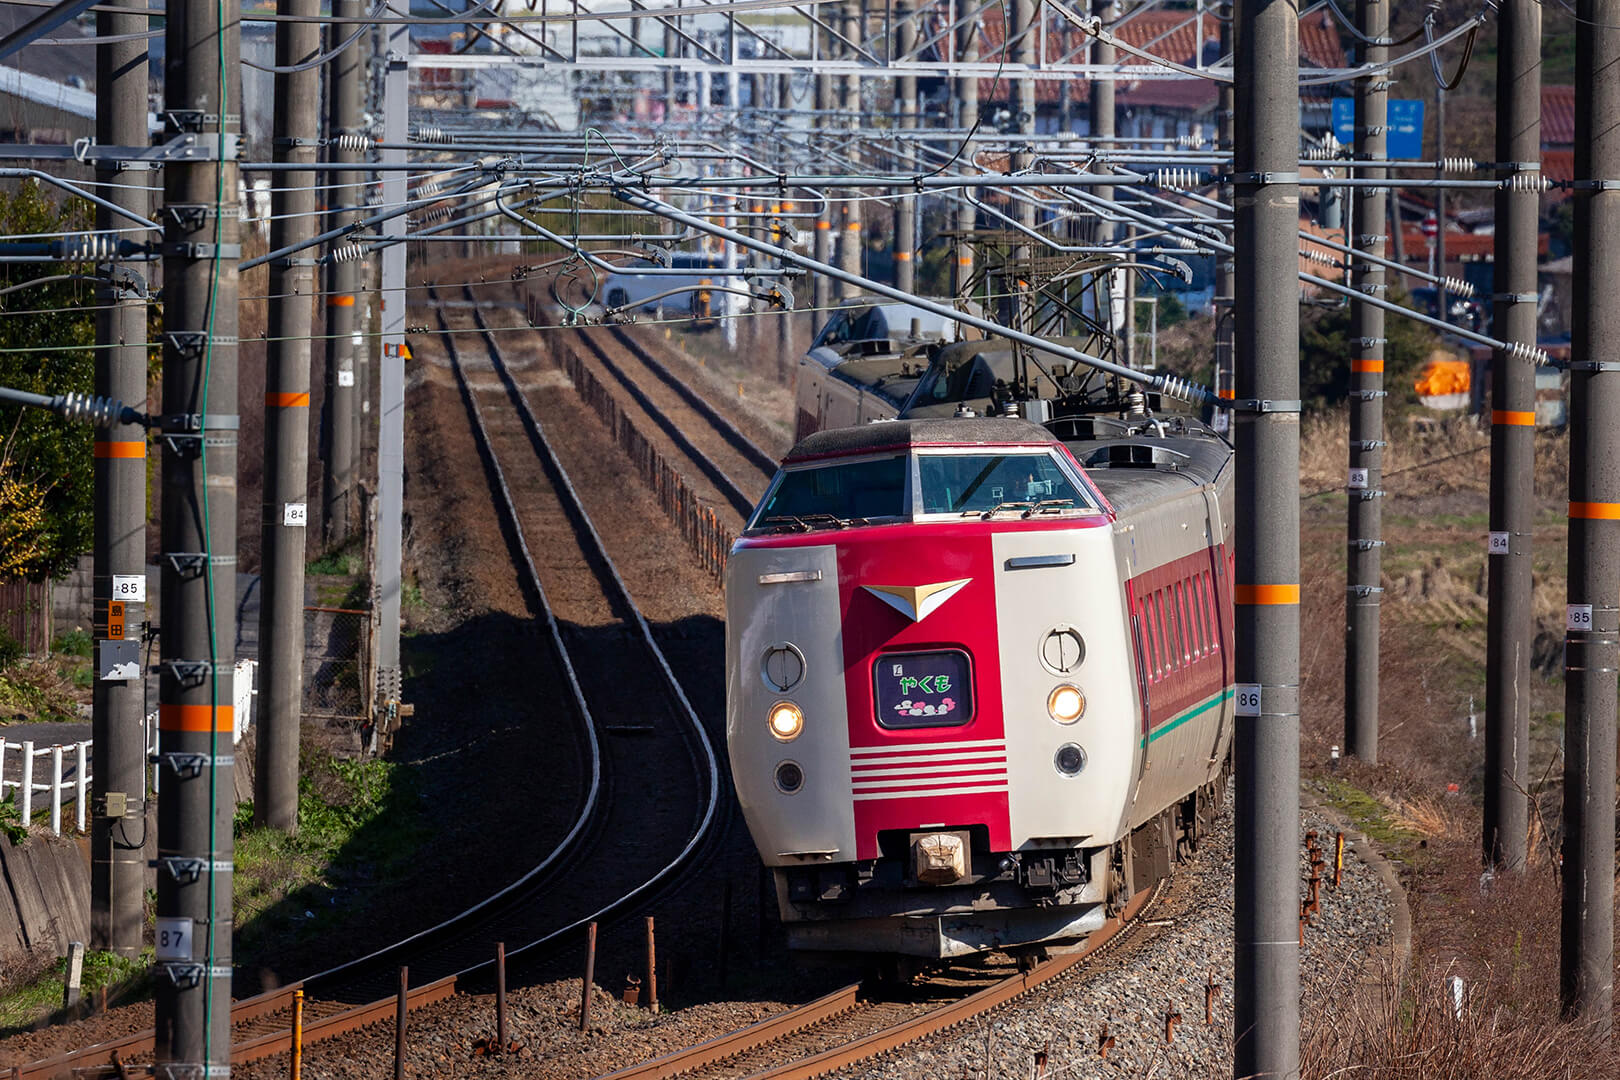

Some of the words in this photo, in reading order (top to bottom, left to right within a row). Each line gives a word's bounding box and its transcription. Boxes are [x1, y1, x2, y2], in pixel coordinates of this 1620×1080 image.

[1351, 473, 1364, 482] 83
[291, 509, 303, 519] 84
[1493, 537, 1506, 547] 84
[121, 583, 138, 594] 85
[111, 605, 122, 636] 島田
[1573, 612, 1590, 623] 85
[900, 675, 952, 695] やくも
[1240, 693, 1258, 706] 86
[160, 930, 184, 948] 87
